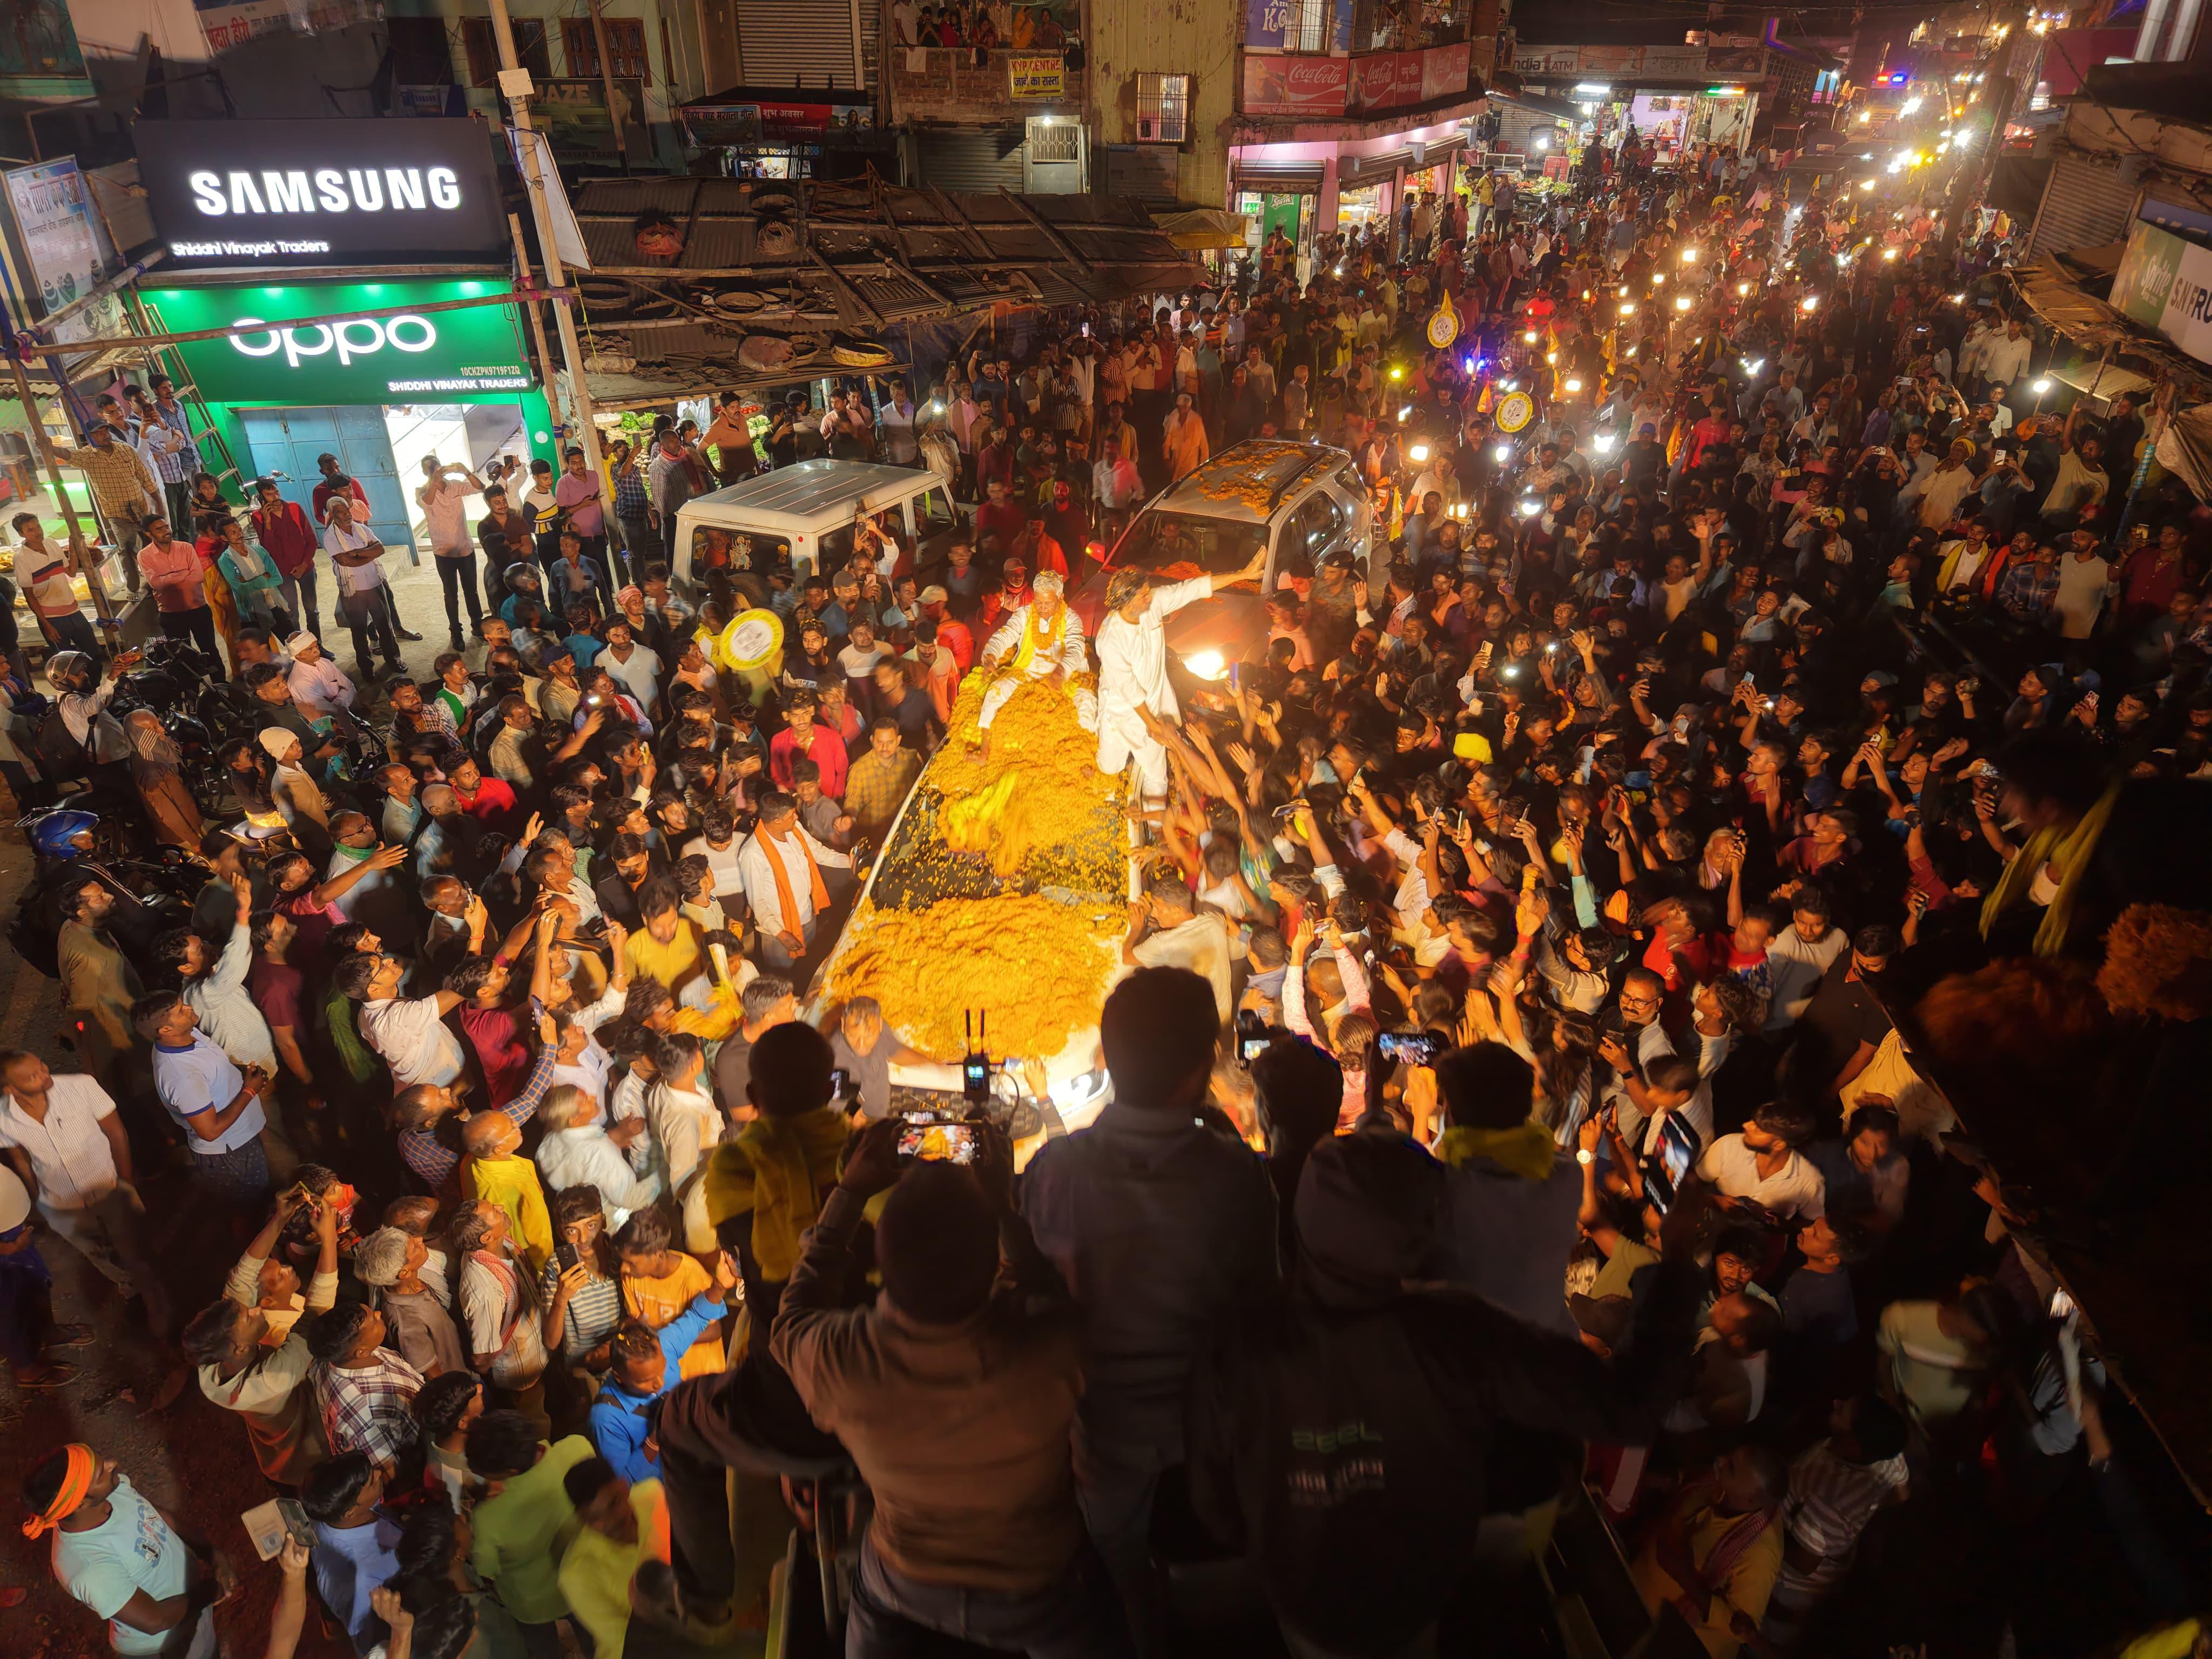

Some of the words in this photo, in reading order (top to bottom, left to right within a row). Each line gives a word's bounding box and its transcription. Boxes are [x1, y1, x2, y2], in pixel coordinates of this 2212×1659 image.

[1011, 60, 1027, 71] KYP
[1029, 59, 1060, 71] CENTRE
[1513, 54, 1551, 71] ndia1
[1552, 61, 1573, 71] ATM
[1014, 73, 1029, 86] जाने
[1030, 77, 1040, 86] का
[1042, 76, 1060, 86] रास्ता
[1289, 64, 1344, 84] Coca-Cola
[763, 109, 778, 119] शुभ
[779, 109, 804, 119] अवसर
[190, 166, 462, 215] SAMSUNG
[172, 242, 222, 257] Shiddhi
[222, 241, 277, 258] Vinayak
[276, 240, 329, 254] Traders
[2140, 255, 2171, 298] Sprite
[229, 315, 436, 368] oppo
[460, 365, 521, 376] 10CKZPK9719F1ZQ
[388, 380, 432, 392] SHIDDHI
[432, 379, 478, 391] VINAYAK
[478, 377, 528, 389] TRADERS
